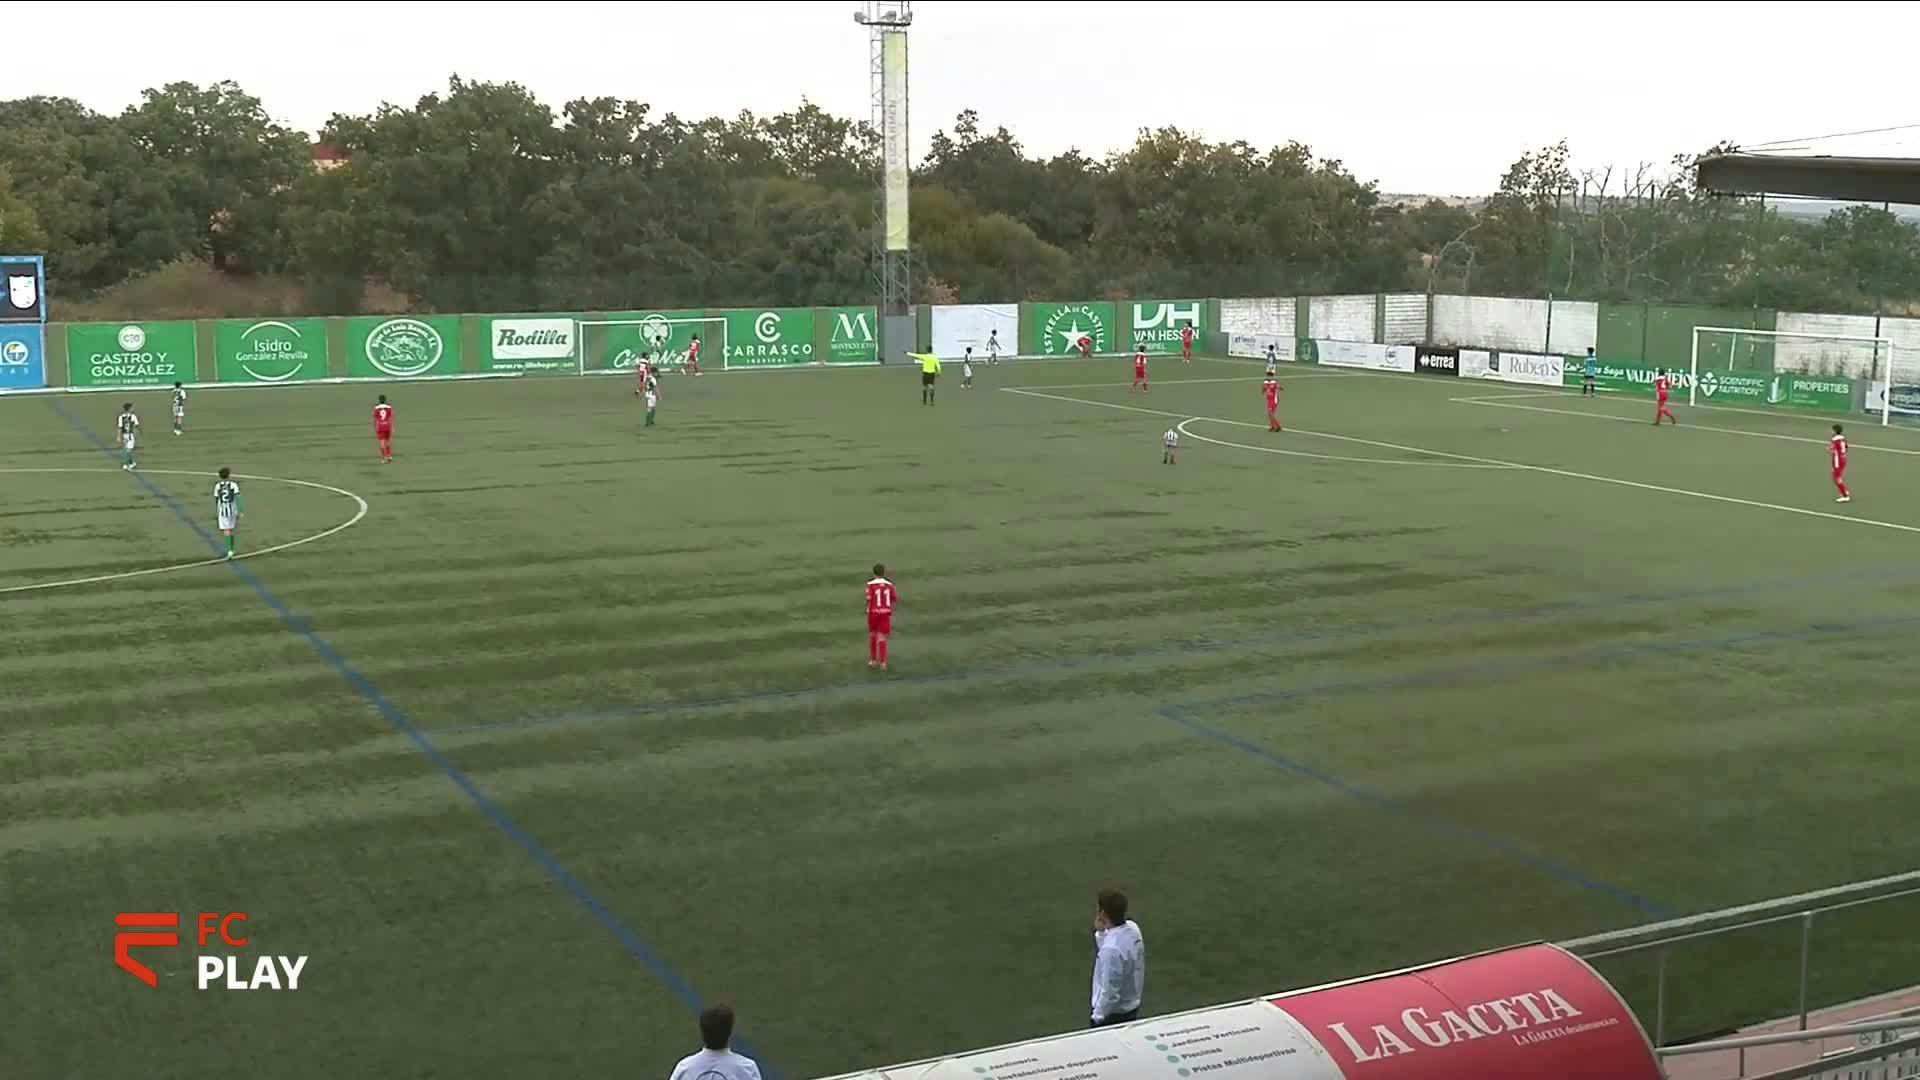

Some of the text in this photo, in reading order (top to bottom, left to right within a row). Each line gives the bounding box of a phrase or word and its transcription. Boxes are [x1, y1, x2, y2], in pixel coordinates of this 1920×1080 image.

[1044, 305, 1072, 353] ESTRELLA
[1081, 305, 1104, 352] CASTILLA
[1133, 328, 1200, 341] VAN HESSN
[254, 338, 292, 352] Isidro
[497, 329, 568, 347] Rodilla
[91, 352, 168, 365] CASTRO Y
[235, 350, 308, 361] González Revilla
[1430, 354, 1455, 369] errea
[91, 364, 176, 377] GONZÁLEZ
[1719, 376, 1764, 386] SCIENTIFIC
[1793, 380, 1849, 394] PROPERTIES
[1718, 385, 1760, 396] NUTRITION
[379, 409, 387, 421] 9
[222, 489, 230, 502] 2
[874, 588, 891, 607] 11
[1327, 988, 1583, 1064] LA GACETA
[1171, 1025, 1261, 1048] Jardines Verticales
[1182, 1047, 1223, 1060] Piscinas
[1192, 1047, 1297, 1074] Pistas Multideportivas
[1066, 1055, 1119, 1069] deportivas
